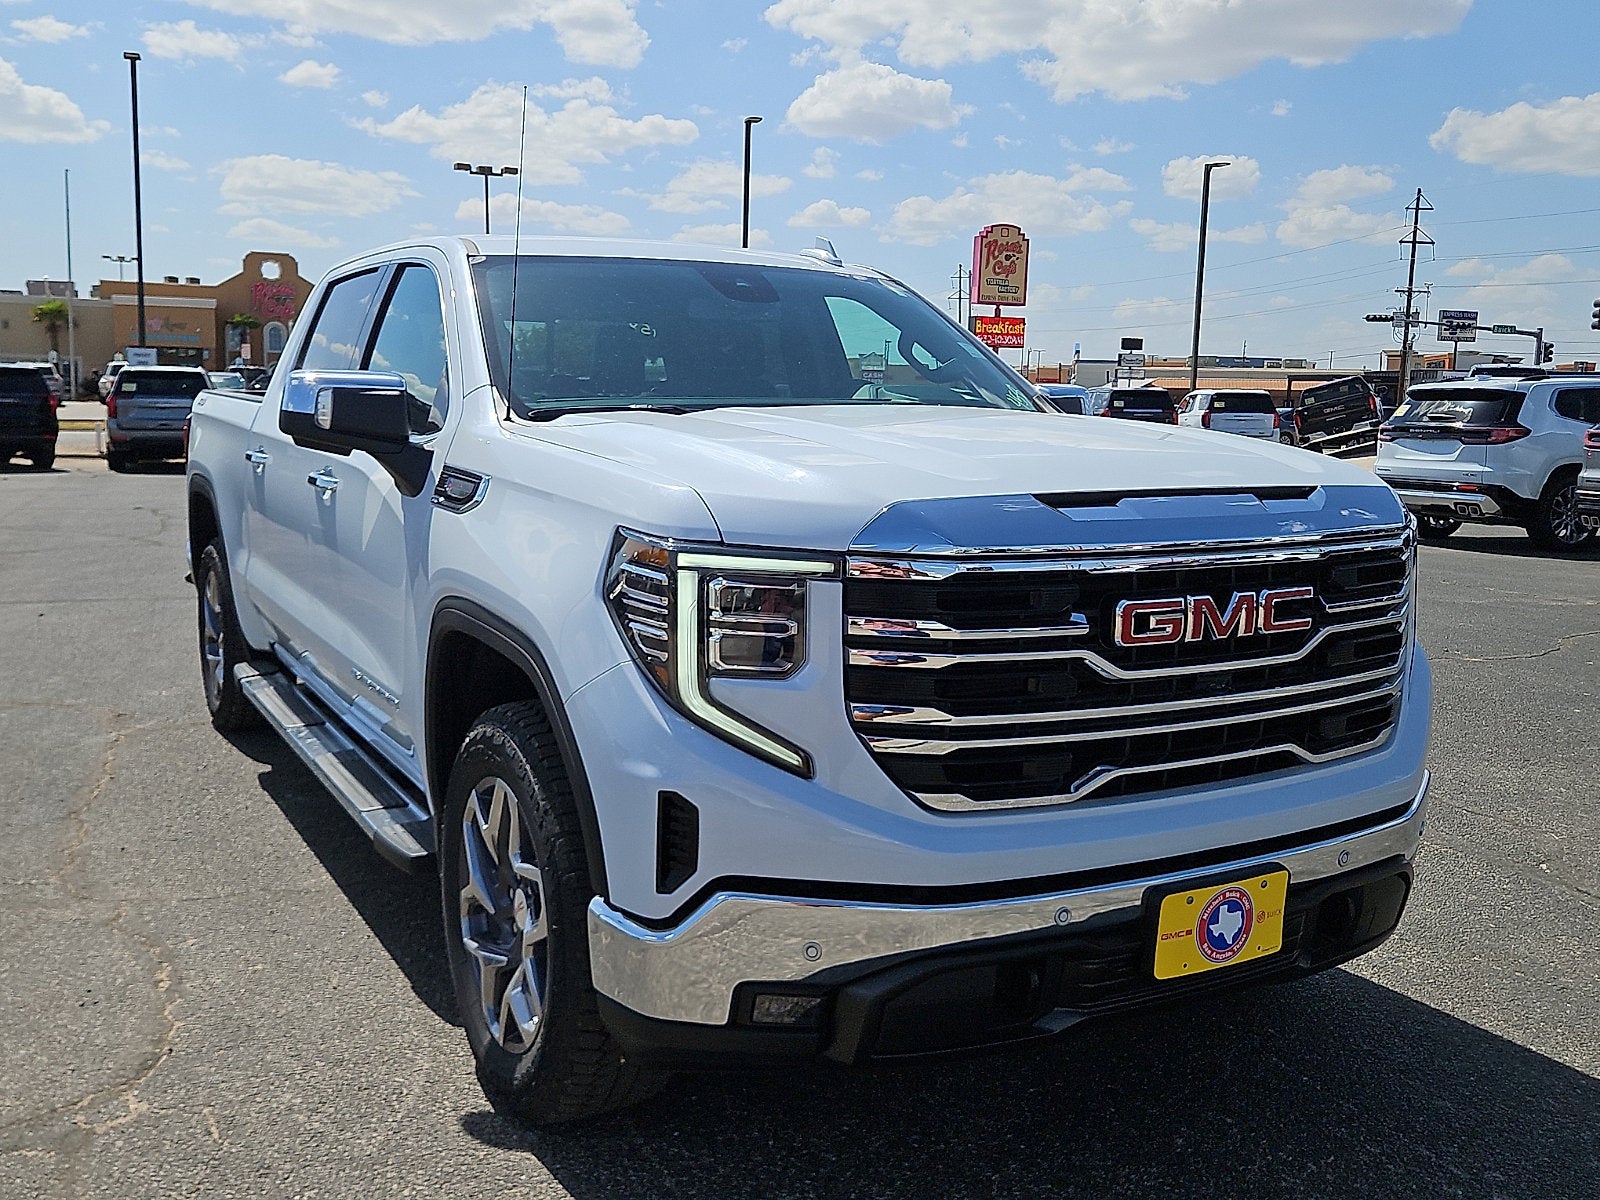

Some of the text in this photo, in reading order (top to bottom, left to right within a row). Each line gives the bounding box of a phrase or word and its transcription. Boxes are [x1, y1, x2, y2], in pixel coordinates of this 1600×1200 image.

[976, 320, 1024, 334] Breakfast
[1115, 586, 1313, 647] GMC
[1225, 890, 1241, 899] Buick
[1160, 931, 1185, 942] GMC
[1202, 942, 1212, 957] San
